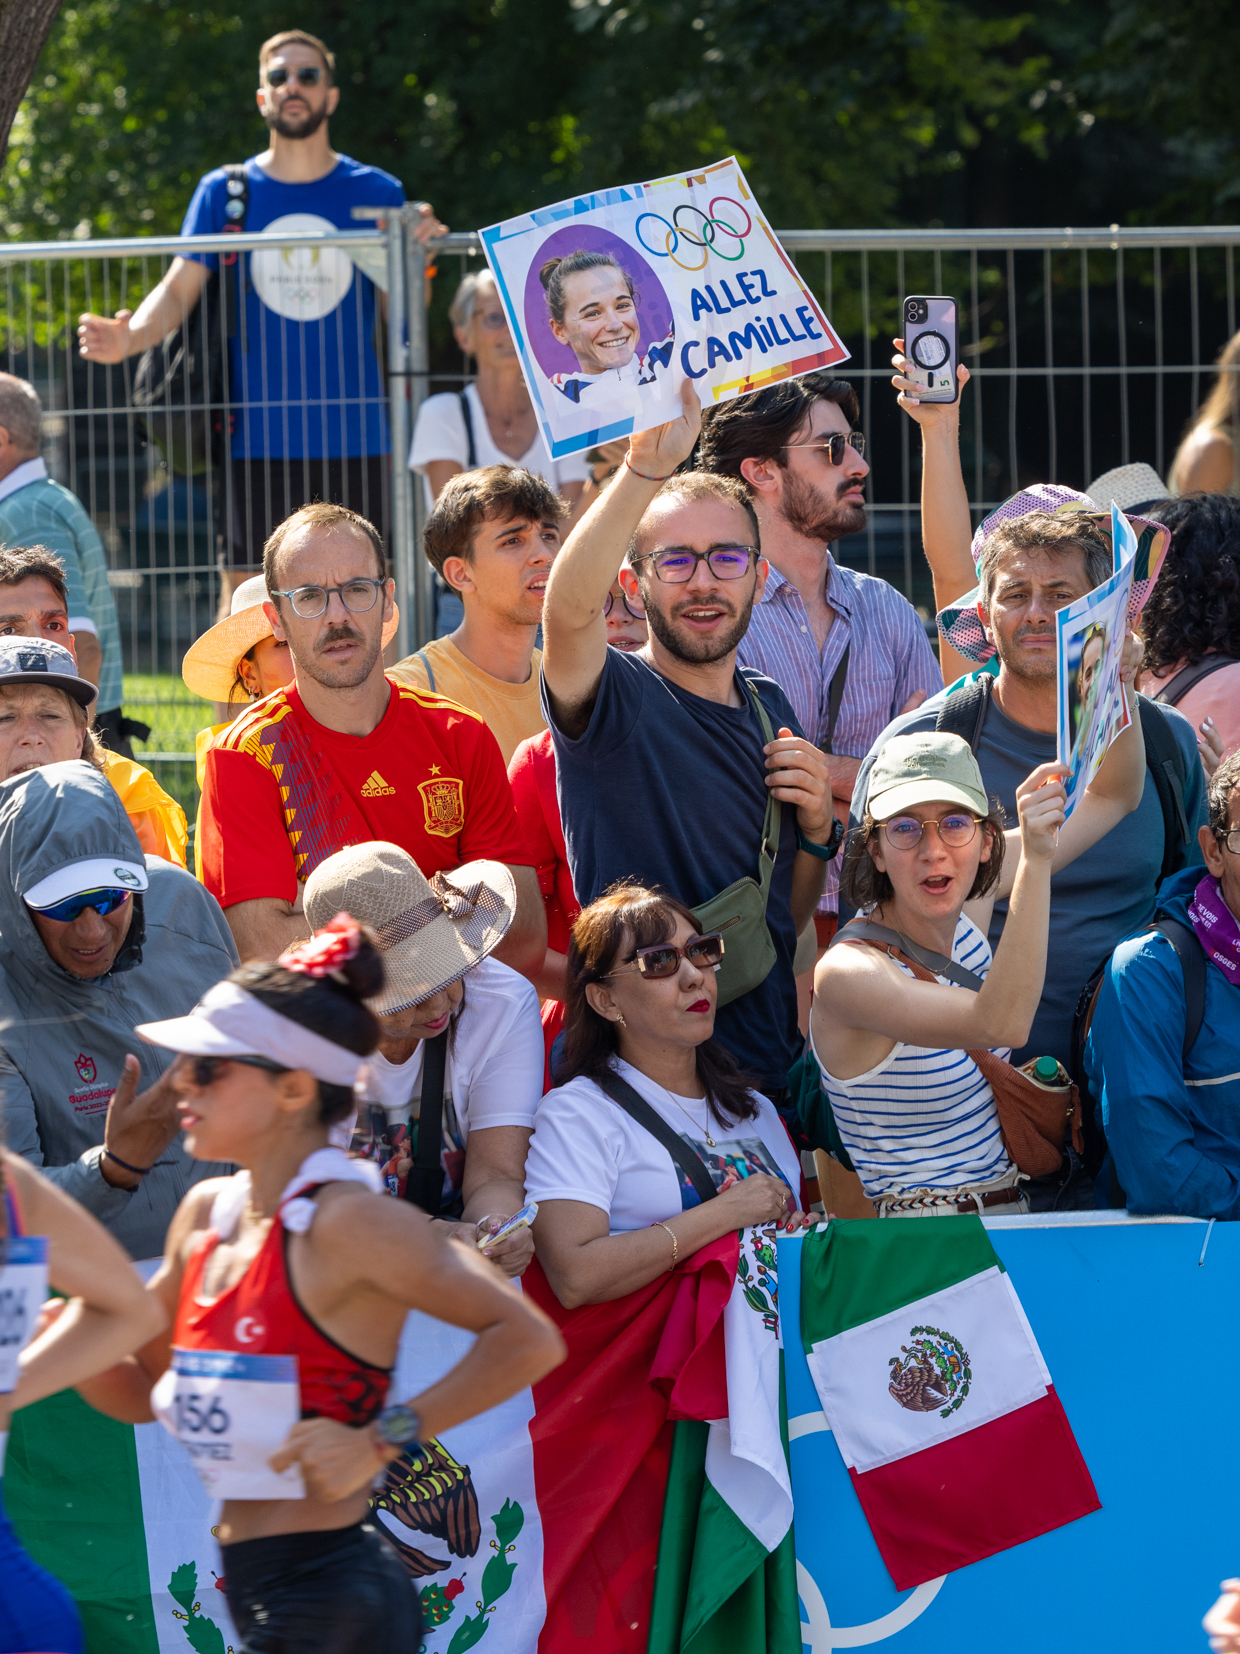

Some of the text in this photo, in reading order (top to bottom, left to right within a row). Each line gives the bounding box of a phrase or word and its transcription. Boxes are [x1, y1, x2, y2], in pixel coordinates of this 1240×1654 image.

[691, 268, 777, 321] ALLEZ
[360, 786, 396, 797] adidas
[1210, 948, 1237, 971] VOSGES
[175, 1393, 231, 1434] 156
